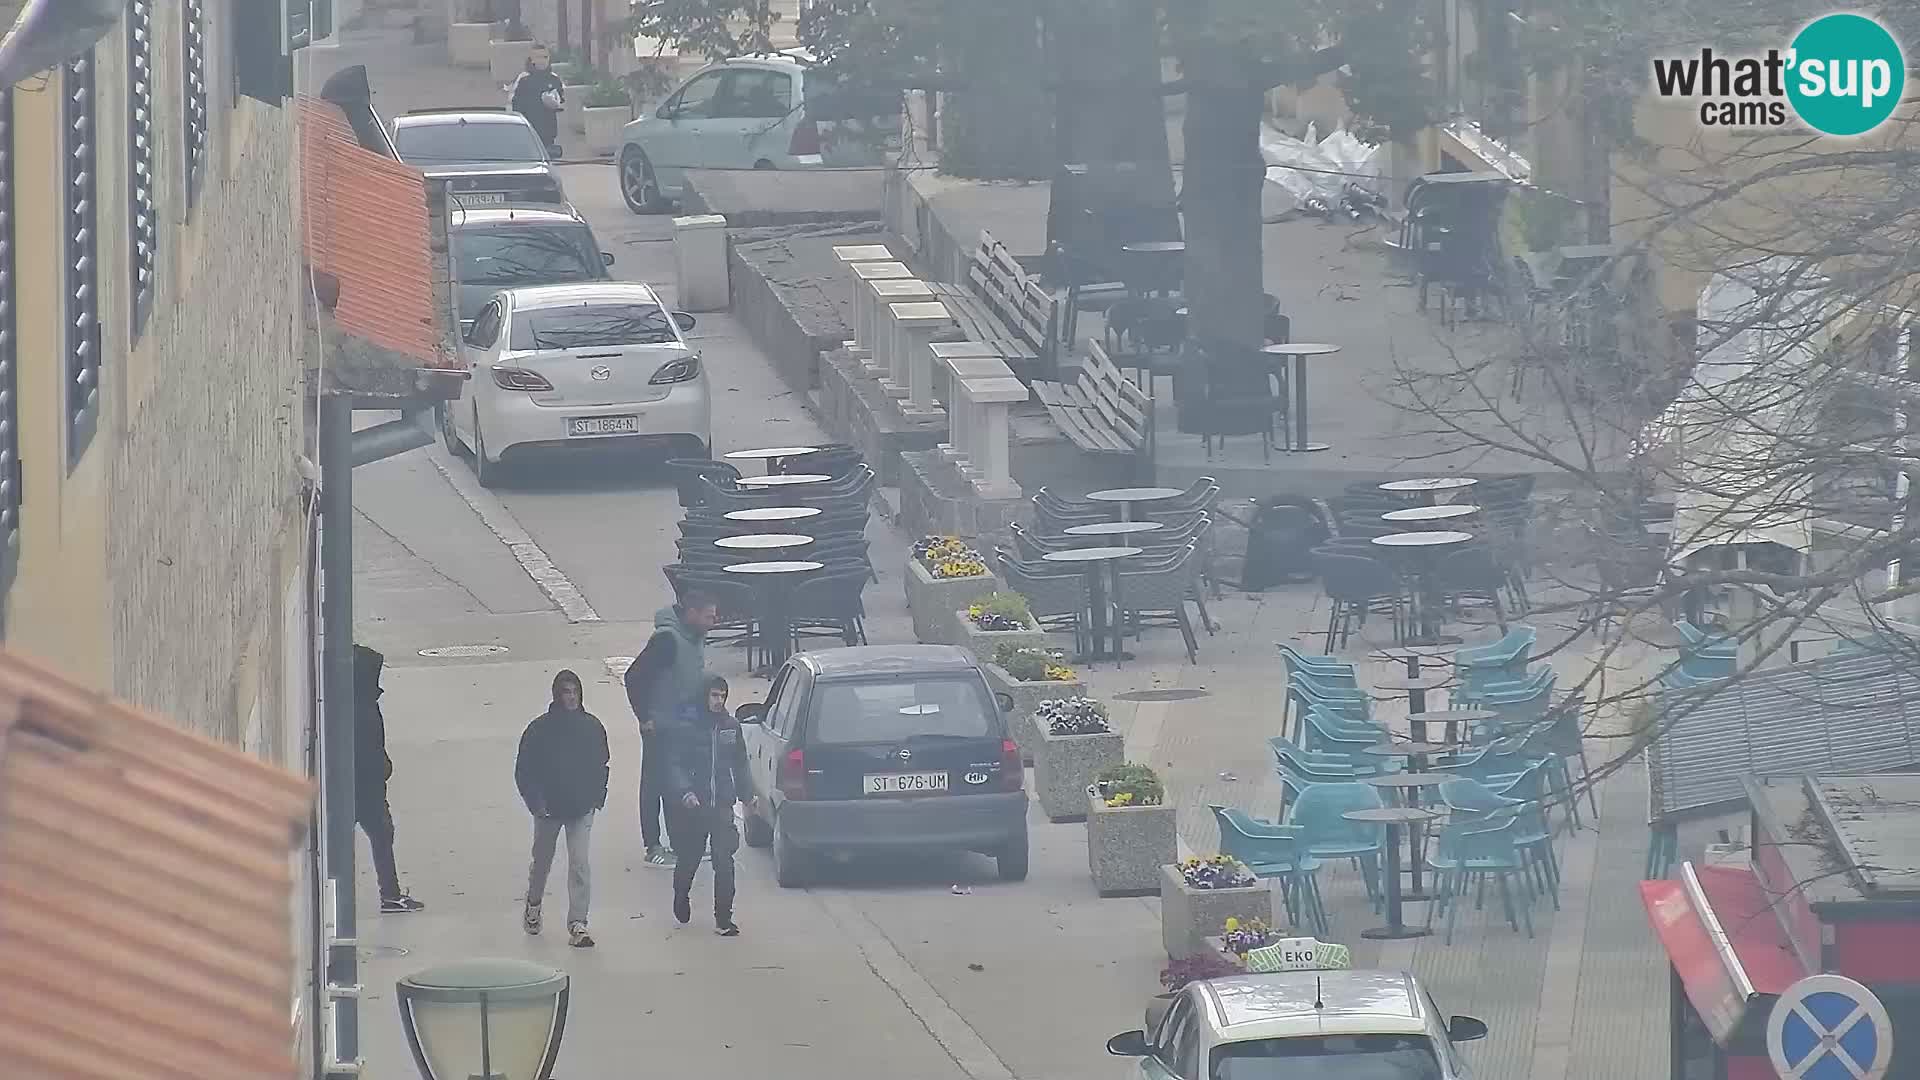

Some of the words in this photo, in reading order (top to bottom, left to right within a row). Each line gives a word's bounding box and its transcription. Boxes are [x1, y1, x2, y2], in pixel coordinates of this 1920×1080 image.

[575, 420, 589, 432] ST
[873, 777, 888, 791] ST
[898, 774, 946, 790] 676-UM
[1285, 951, 1313, 962] EKO
